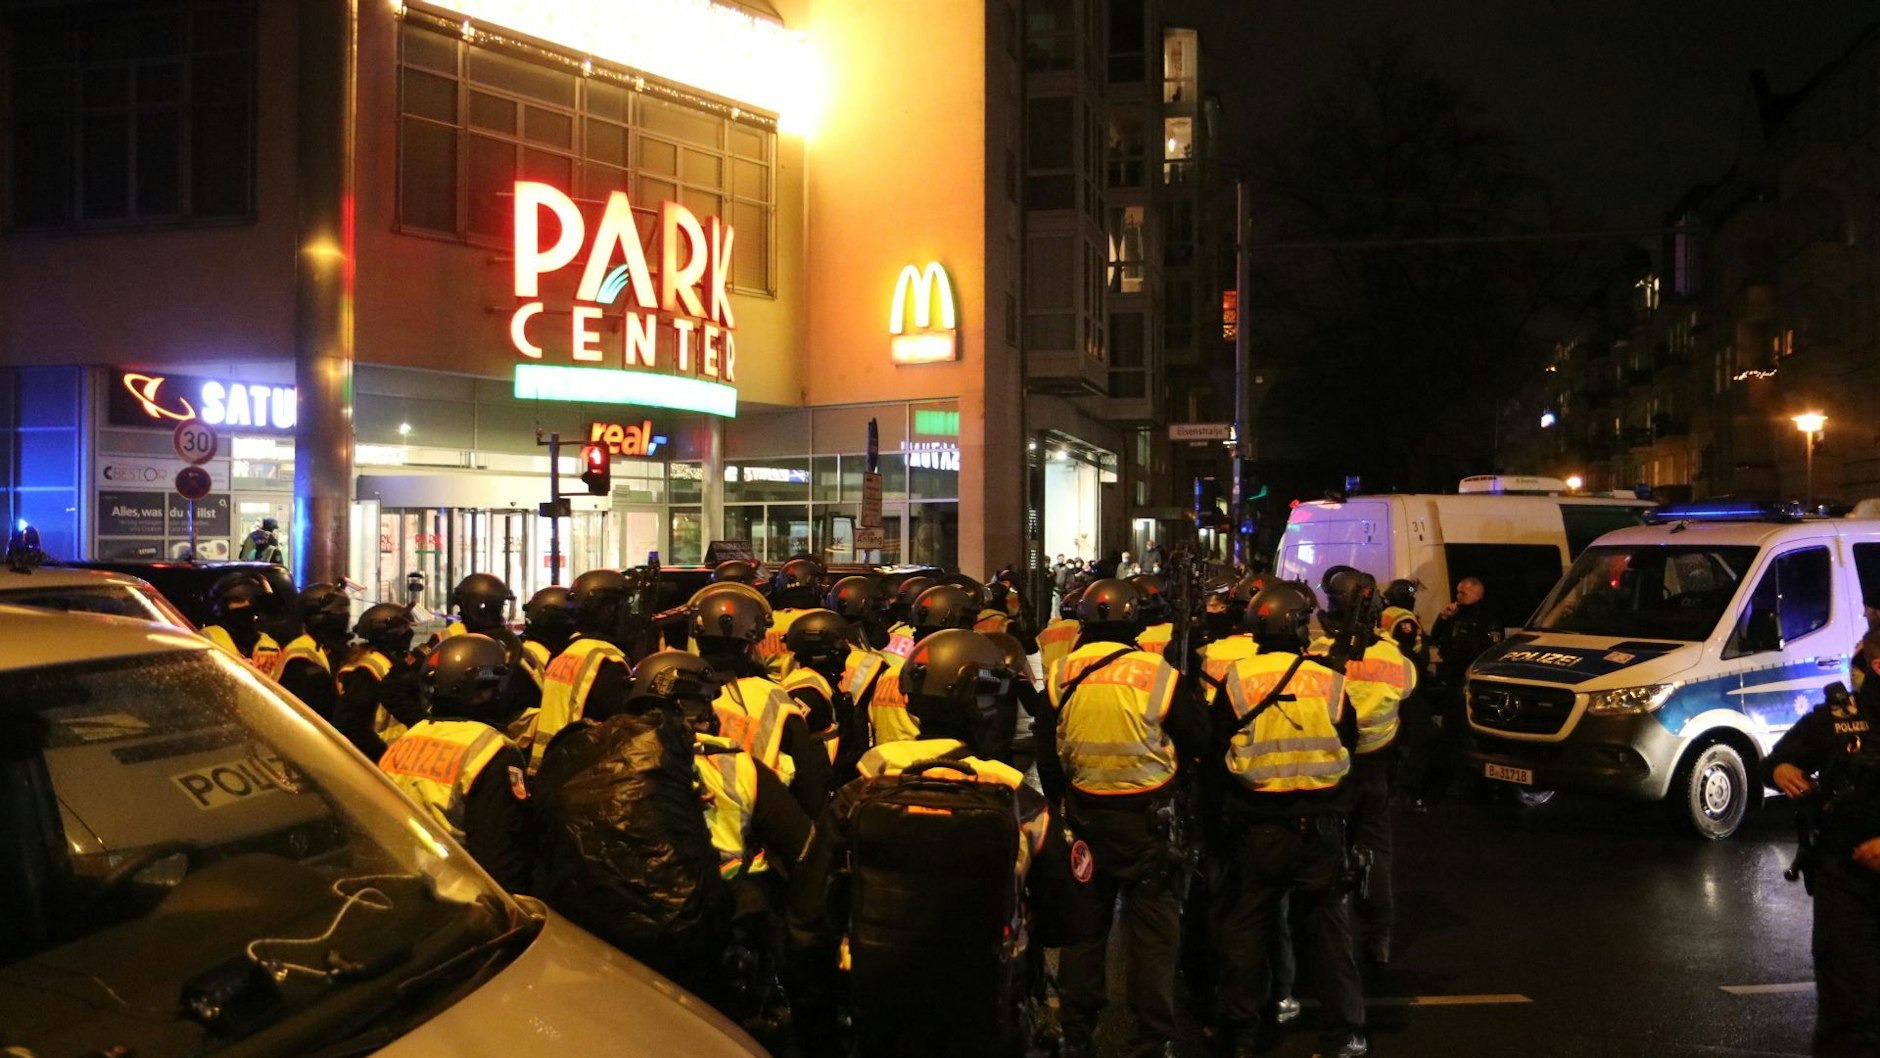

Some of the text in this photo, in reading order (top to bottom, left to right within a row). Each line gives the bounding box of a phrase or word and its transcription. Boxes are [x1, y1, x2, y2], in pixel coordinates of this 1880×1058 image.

[514, 180, 735, 331] PARK
[510, 302, 736, 382] CENTER
[201, 381, 298, 429] SATU
[183, 431, 209, 452] 30
[112, 506, 141, 519] Alles,
[141, 508, 162, 518] was
[170, 507, 184, 518] du
[1363, 522, 1376, 533] 31
[1412, 521, 1425, 532] 31
[1500, 651, 1584, 667] POLIZEI
[1834, 720, 1869, 734] POLIZEI
[1499, 767, 1527, 783] 31718
